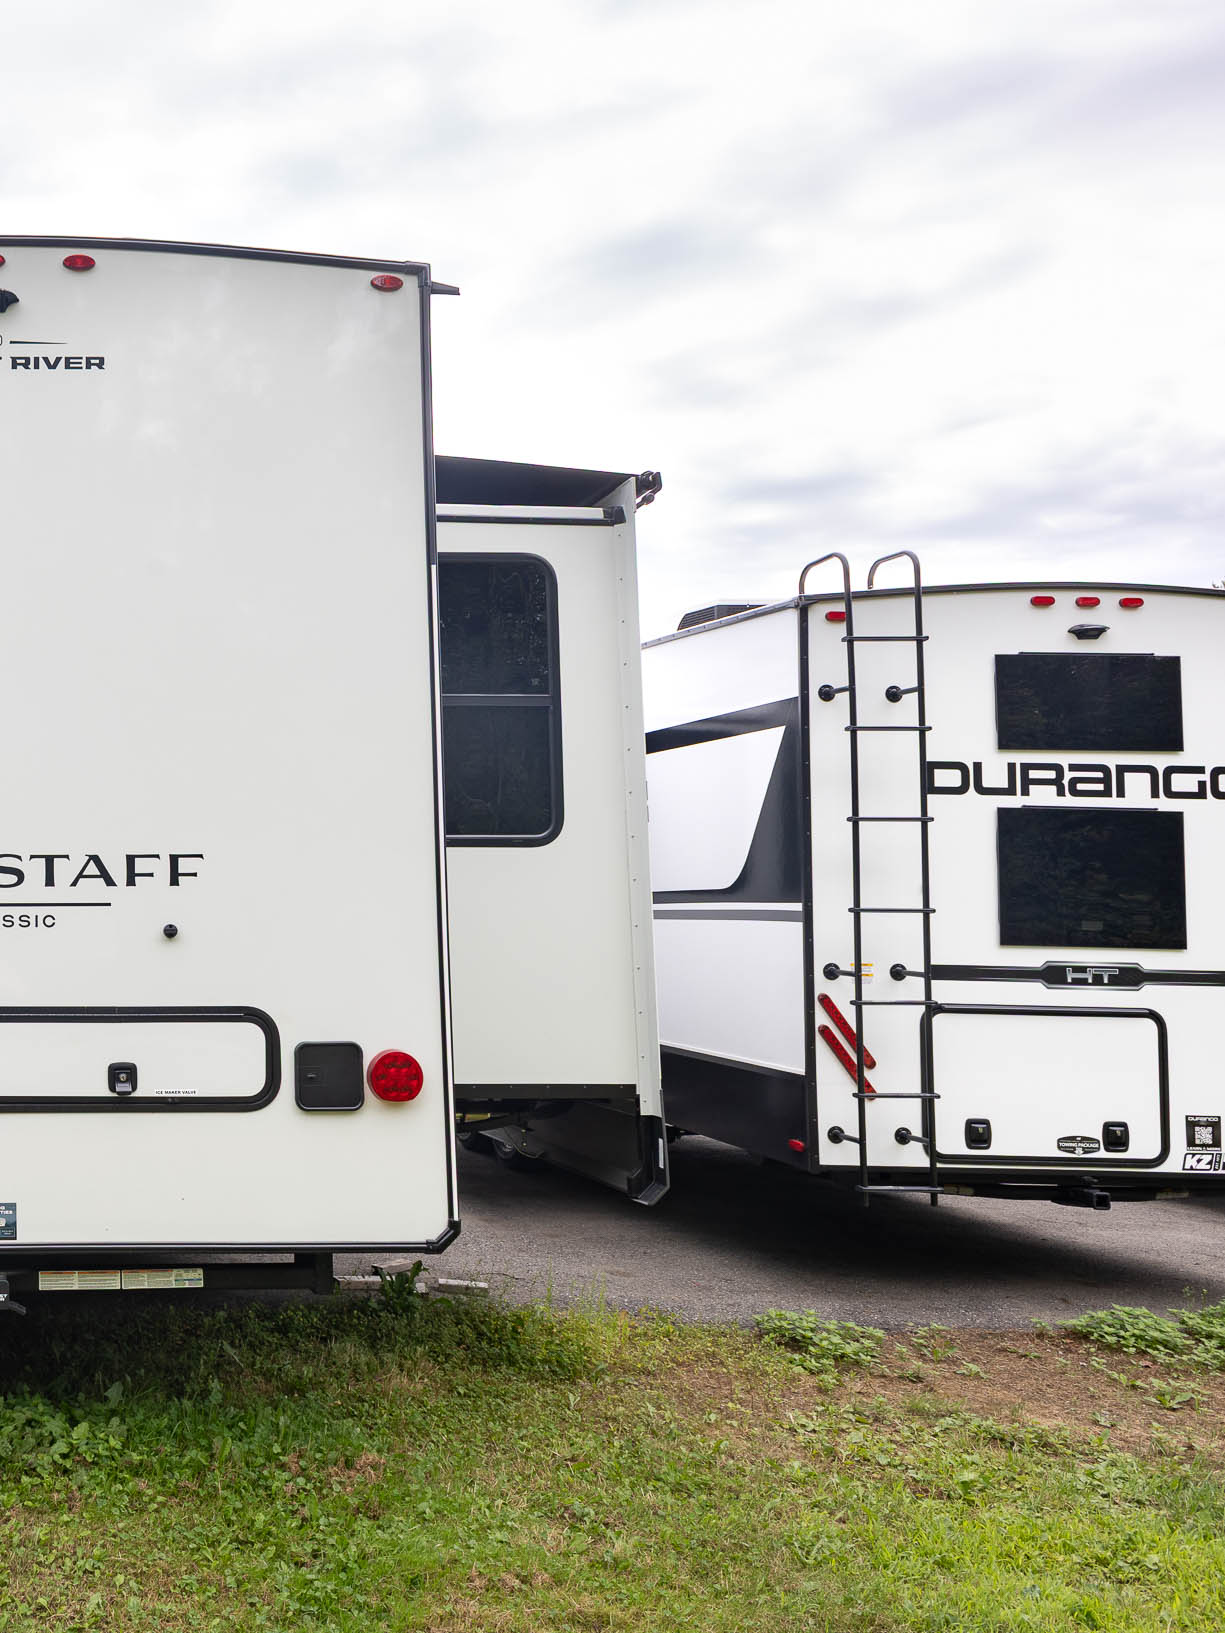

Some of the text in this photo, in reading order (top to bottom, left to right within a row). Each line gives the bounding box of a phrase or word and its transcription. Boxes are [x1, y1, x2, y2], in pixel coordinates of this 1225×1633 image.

[9, 355, 105, 370] RIVER
[1066, 967, 1119, 984] HT
[1184, 1153, 1213, 1170] KZ
